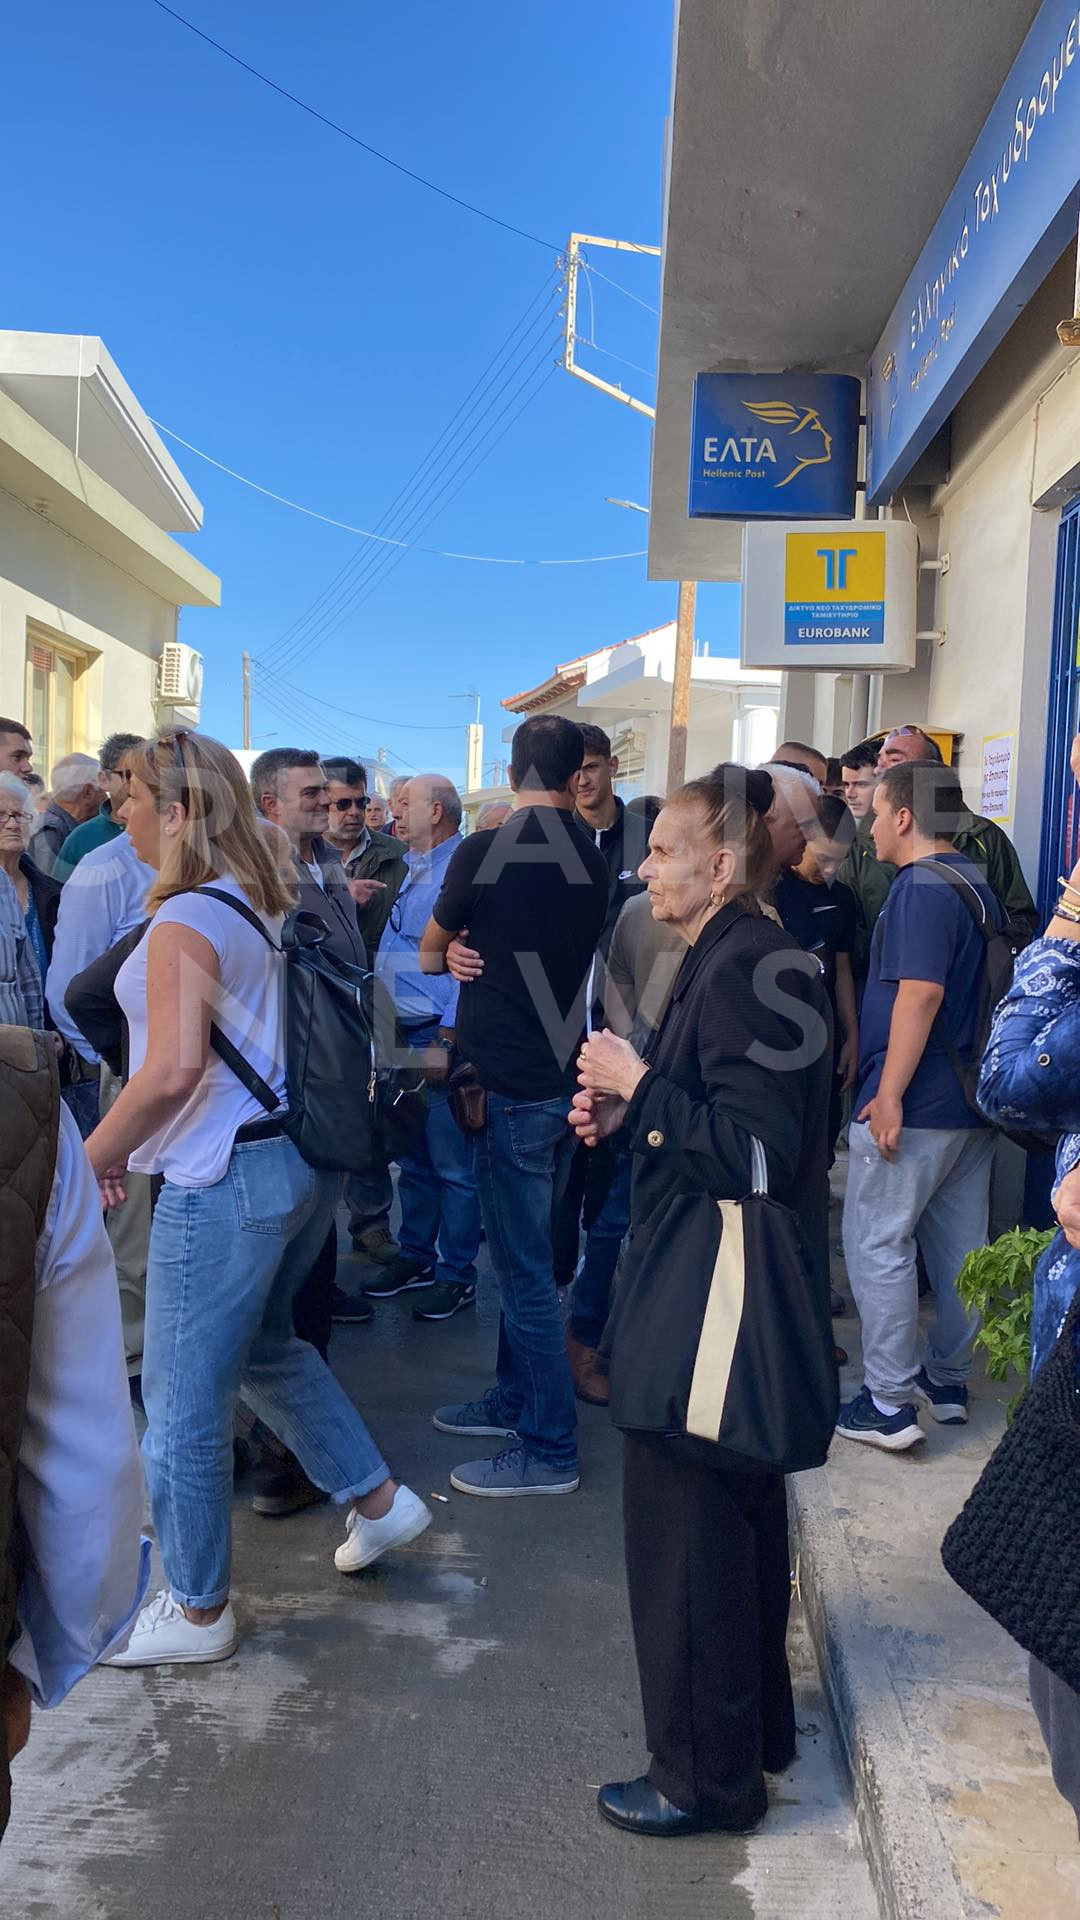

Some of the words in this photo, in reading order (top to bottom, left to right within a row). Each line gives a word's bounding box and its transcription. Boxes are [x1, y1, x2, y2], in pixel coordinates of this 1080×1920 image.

[703, 437, 777, 463] ΕΛΤΑ
[703, 469, 743, 478] Hellenic
[745, 469, 766, 479] Post
[798, 627, 870, 638] EUROBANK
